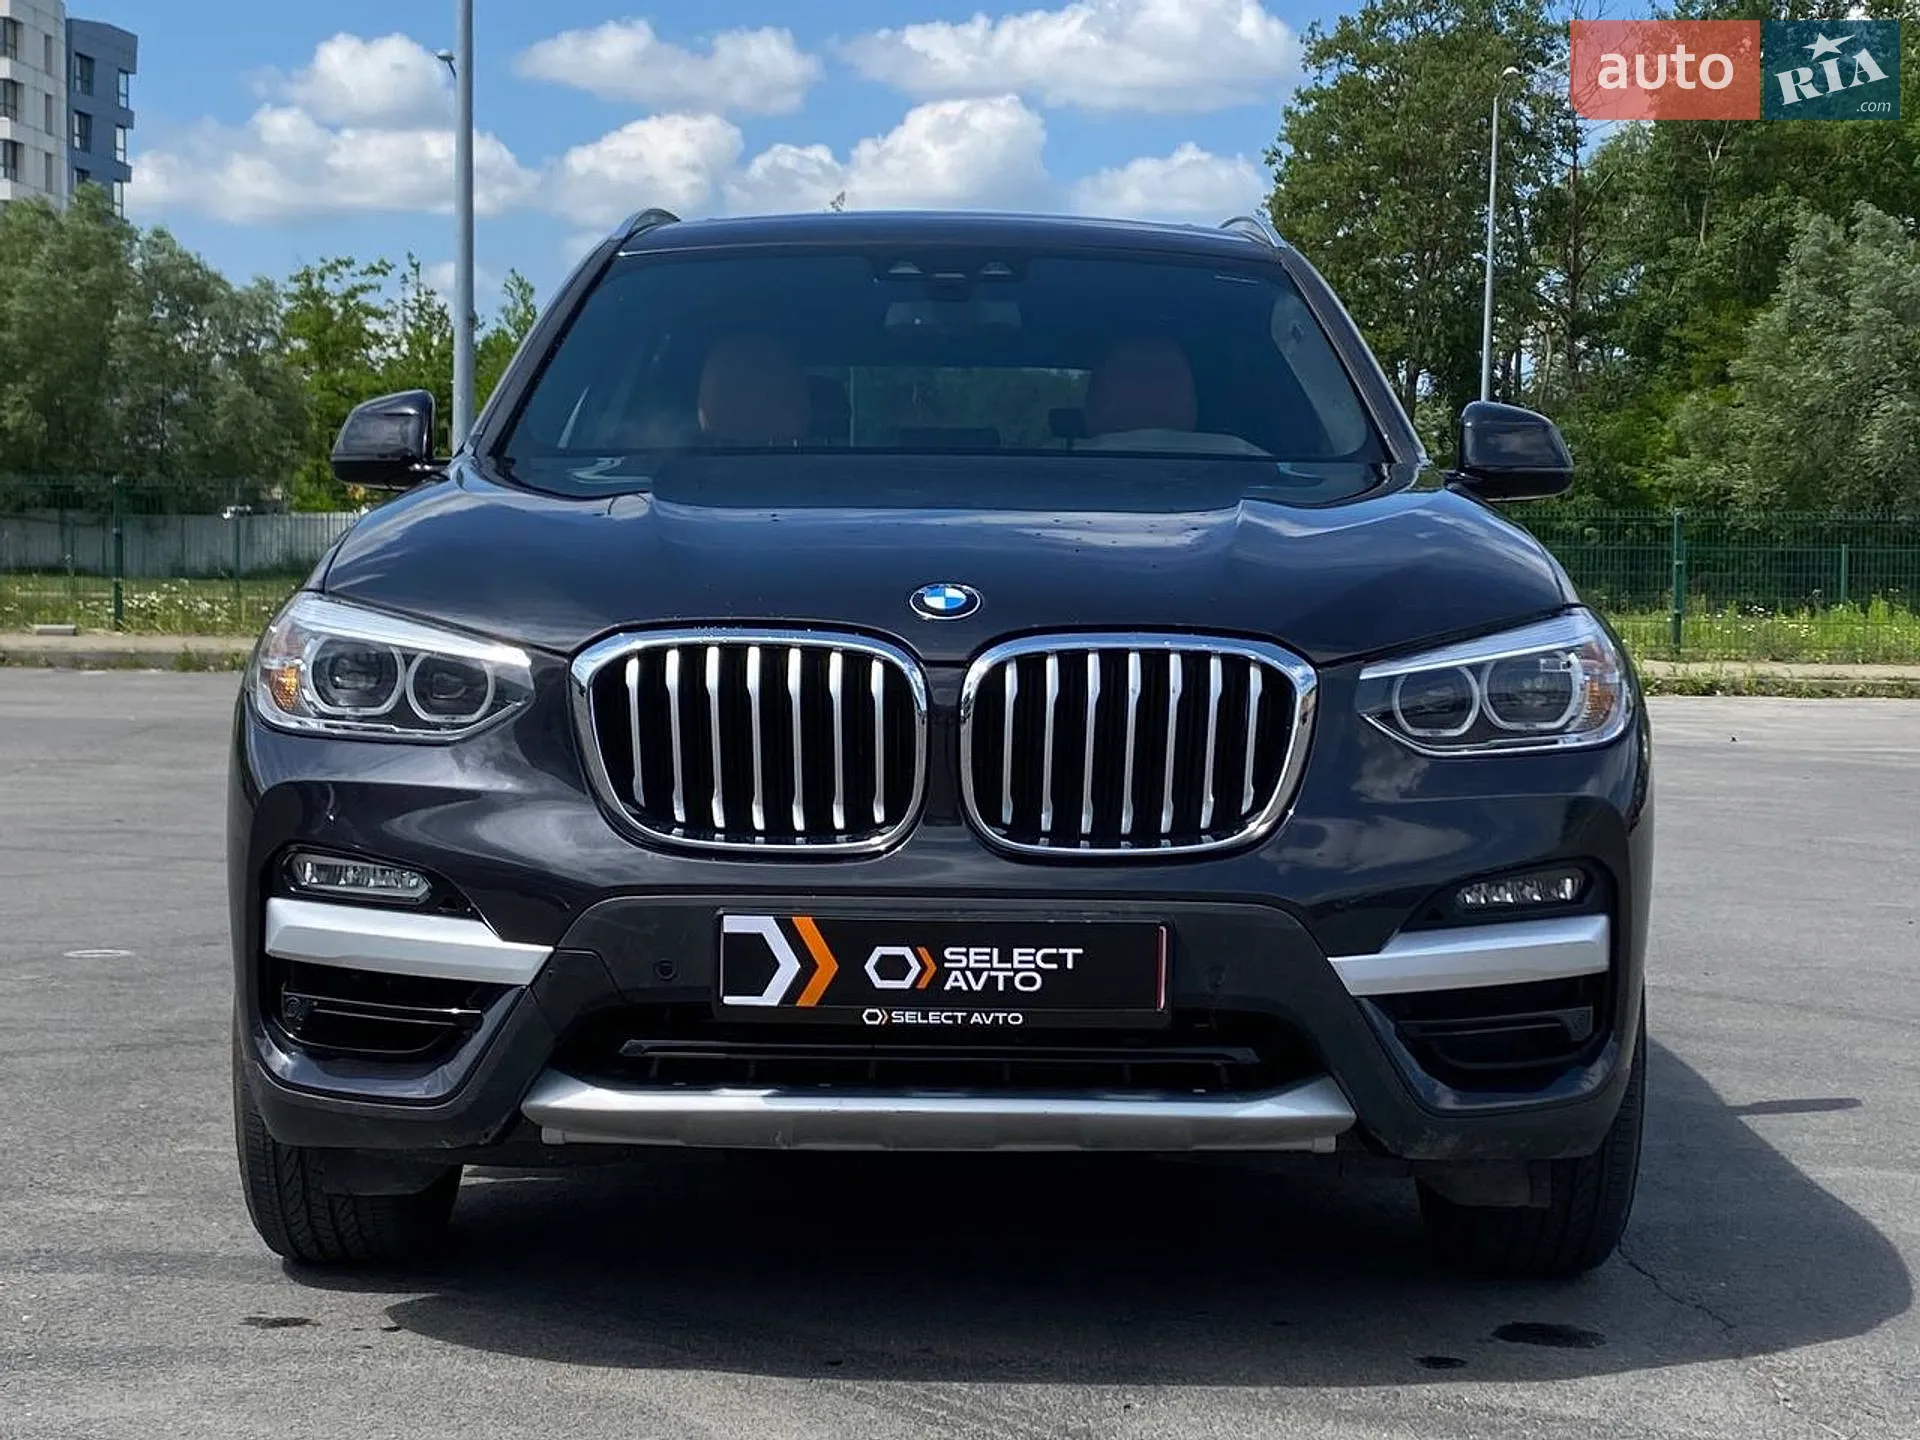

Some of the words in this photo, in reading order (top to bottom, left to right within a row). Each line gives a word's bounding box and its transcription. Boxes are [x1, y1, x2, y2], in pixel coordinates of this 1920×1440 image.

[943, 947, 1083, 969] SELECT
[943, 971, 1042, 992] AVTO
[891, 1010, 966, 1025] SELECT
[970, 1012, 1023, 1026] AVTO
